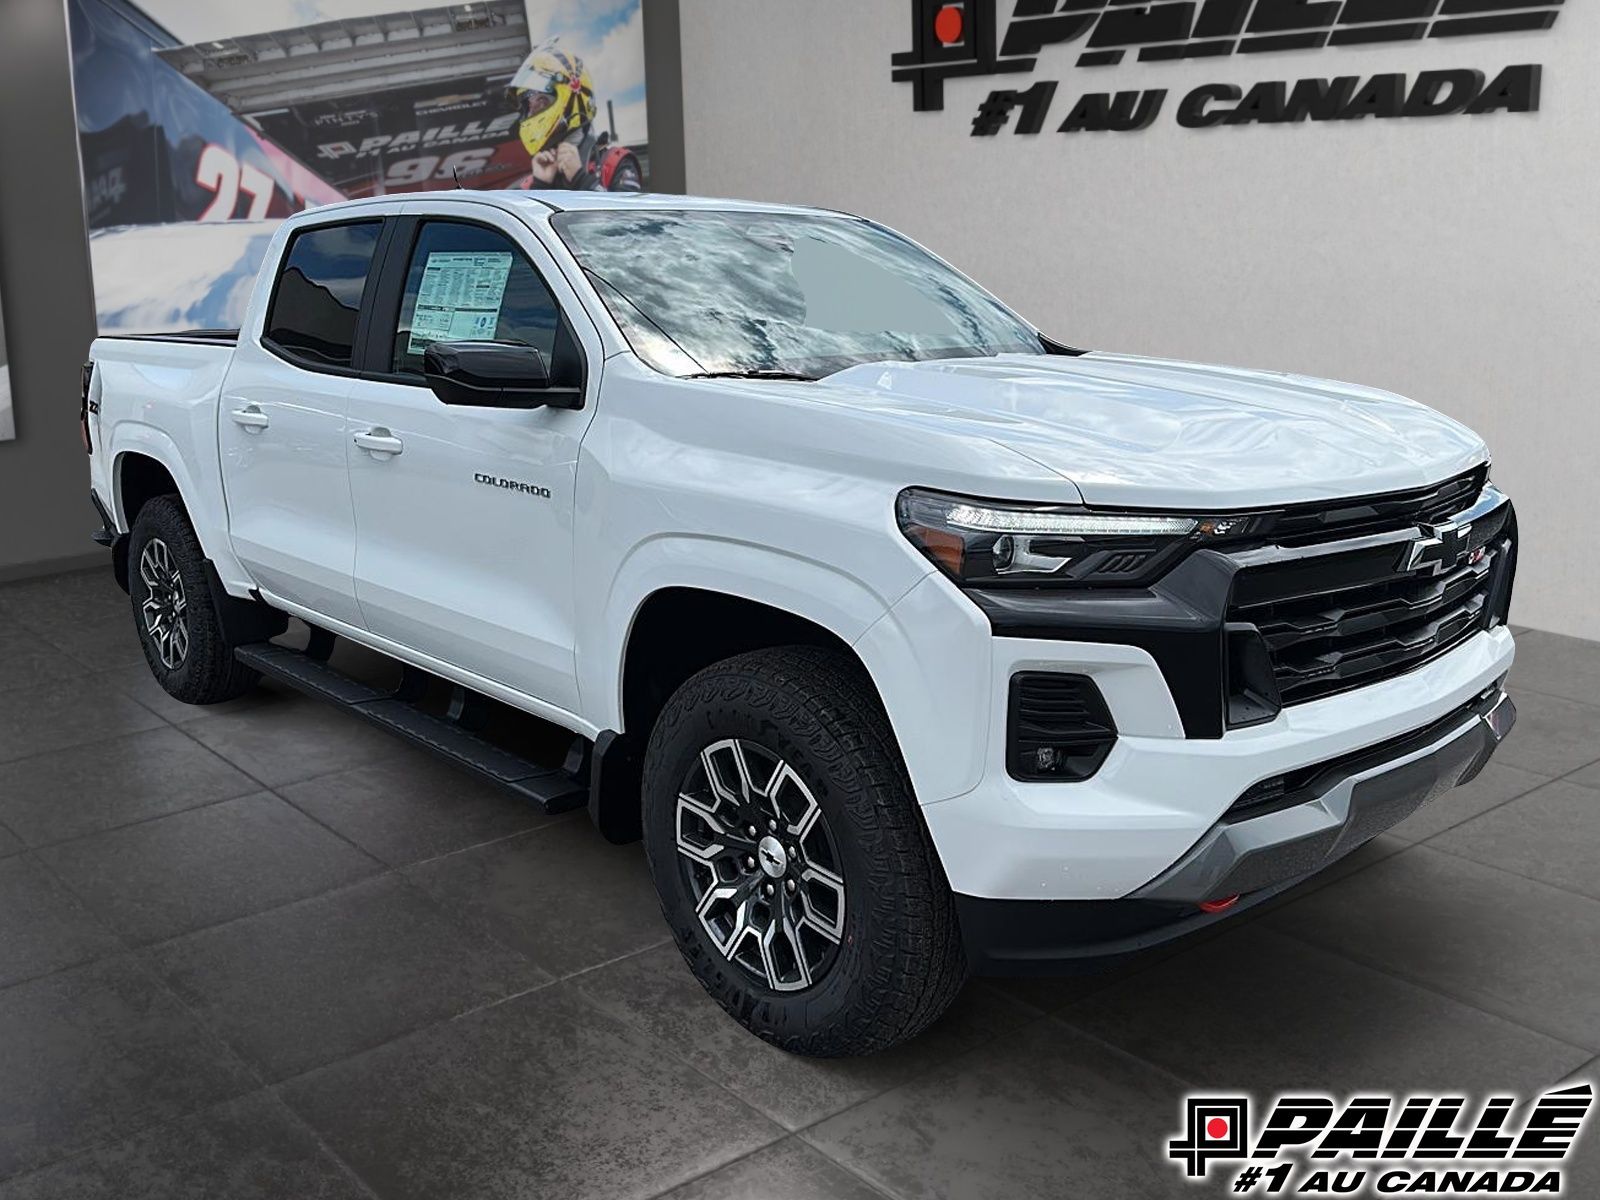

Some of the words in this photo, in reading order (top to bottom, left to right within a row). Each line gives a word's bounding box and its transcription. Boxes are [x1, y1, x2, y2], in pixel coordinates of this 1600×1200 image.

[995, 0, 1567, 72] PAI
[416, 101, 488, 116] CHEVROLET
[970, 81, 1058, 136] #1
[1056, 89, 1168, 132] AU
[1176, 64, 1541, 128] CANADA
[197, 144, 275, 222] 27
[474, 473, 551, 499] COLORADO
